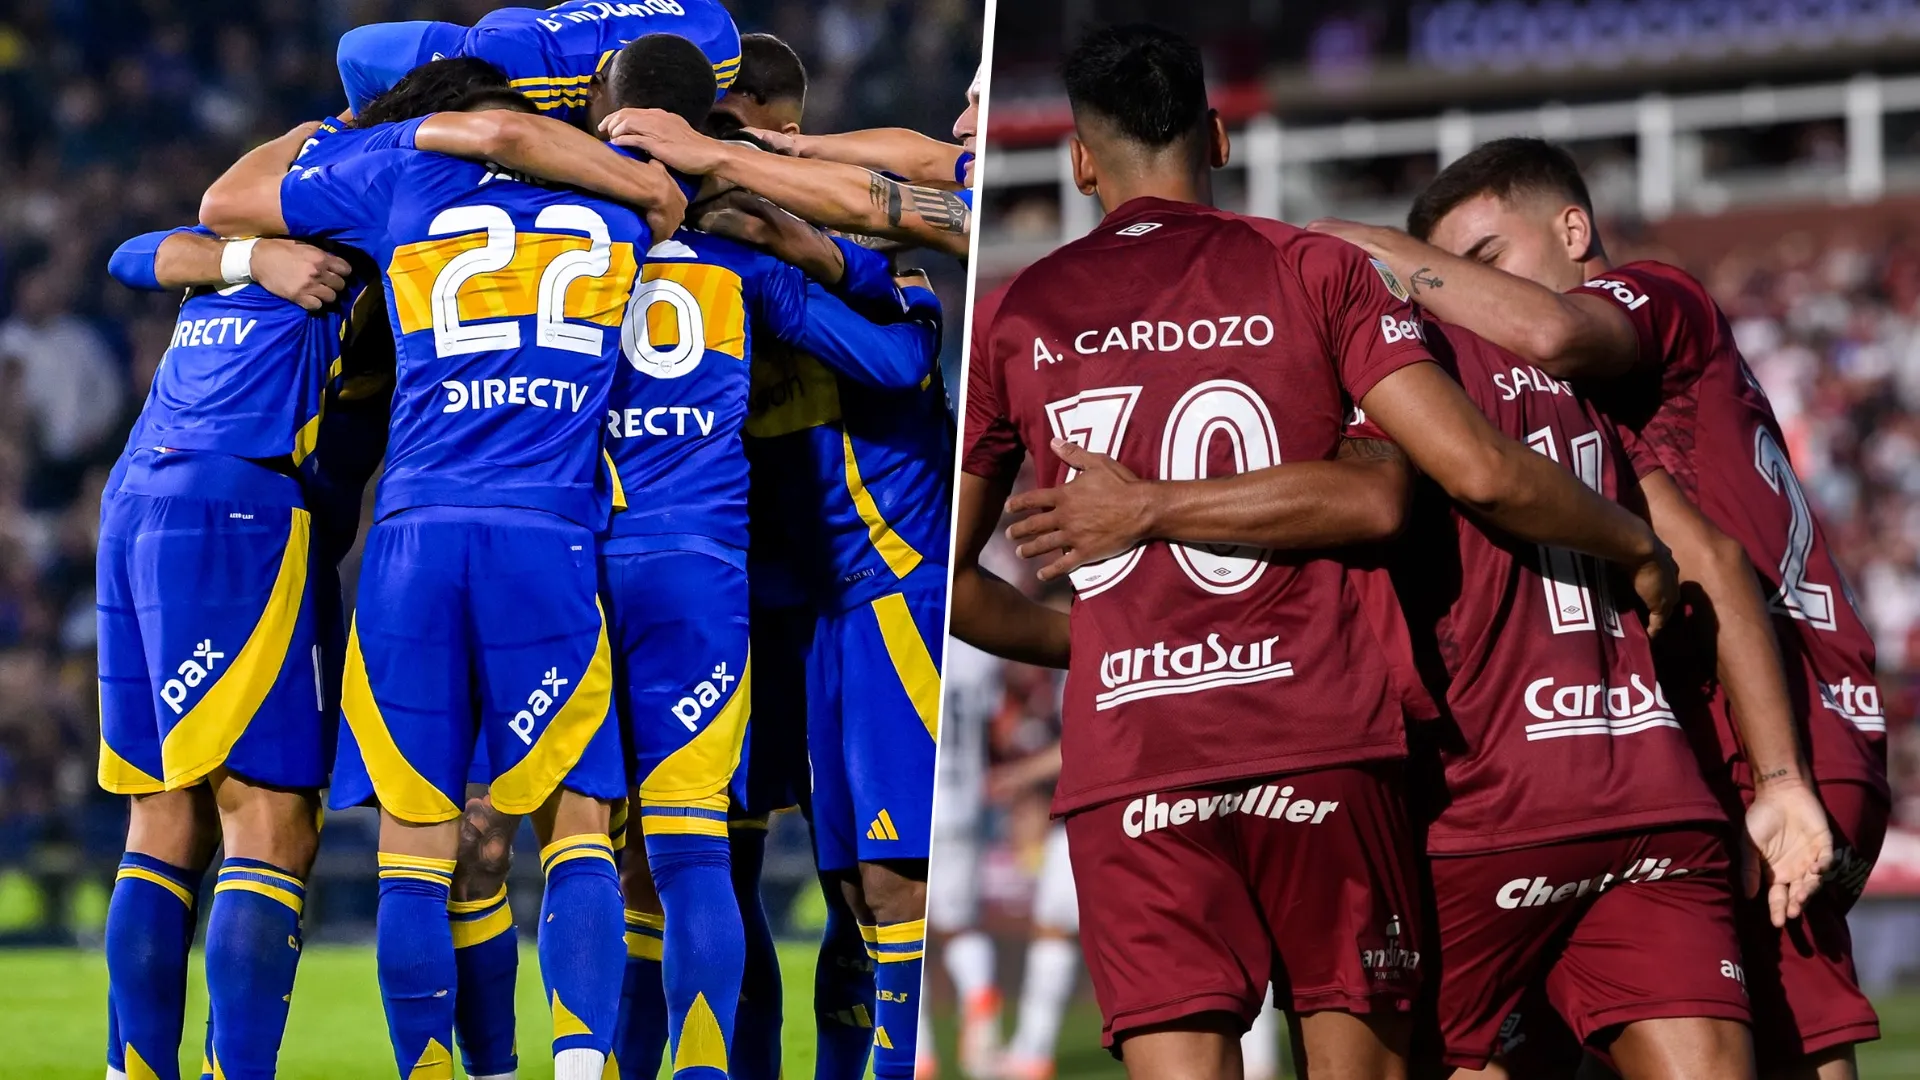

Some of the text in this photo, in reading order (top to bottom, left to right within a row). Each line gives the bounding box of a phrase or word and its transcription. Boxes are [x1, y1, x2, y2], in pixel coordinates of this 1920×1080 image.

[428, 204, 612, 358] 22
[1033, 315, 1275, 371] A. CARDOZO
[441, 376, 589, 414] DIRECTV
[160, 638, 225, 715] pax
[507, 666, 569, 746] pax
[671, 661, 735, 732] pax
[1122, 785, 1340, 839] Chevallier
